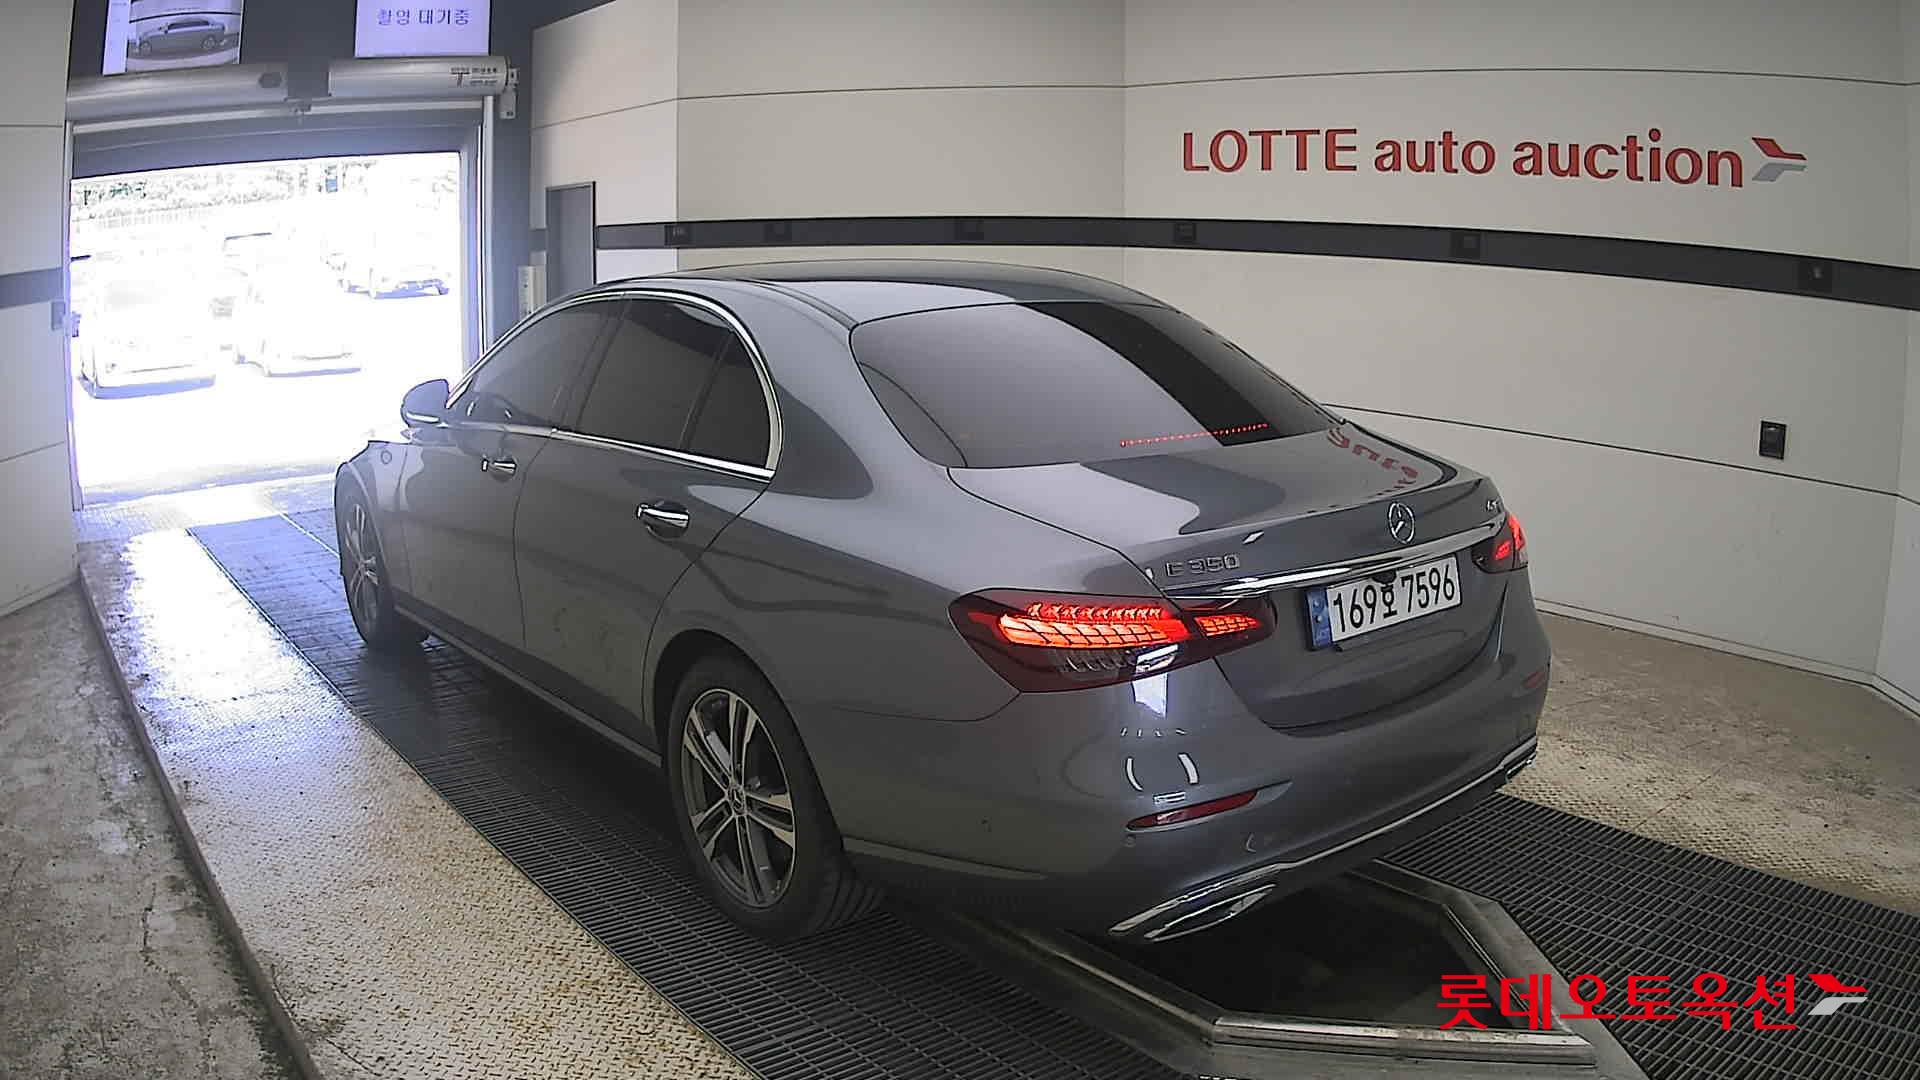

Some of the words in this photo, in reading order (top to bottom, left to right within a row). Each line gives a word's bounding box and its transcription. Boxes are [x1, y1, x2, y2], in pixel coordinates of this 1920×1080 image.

[1183, 128, 1358, 172] LOTTE
[1375, 131, 1496, 174] auto
[1512, 128, 1744, 187] auction
[1165, 561, 1184, 577] E
[1187, 554, 1240, 575] 350
